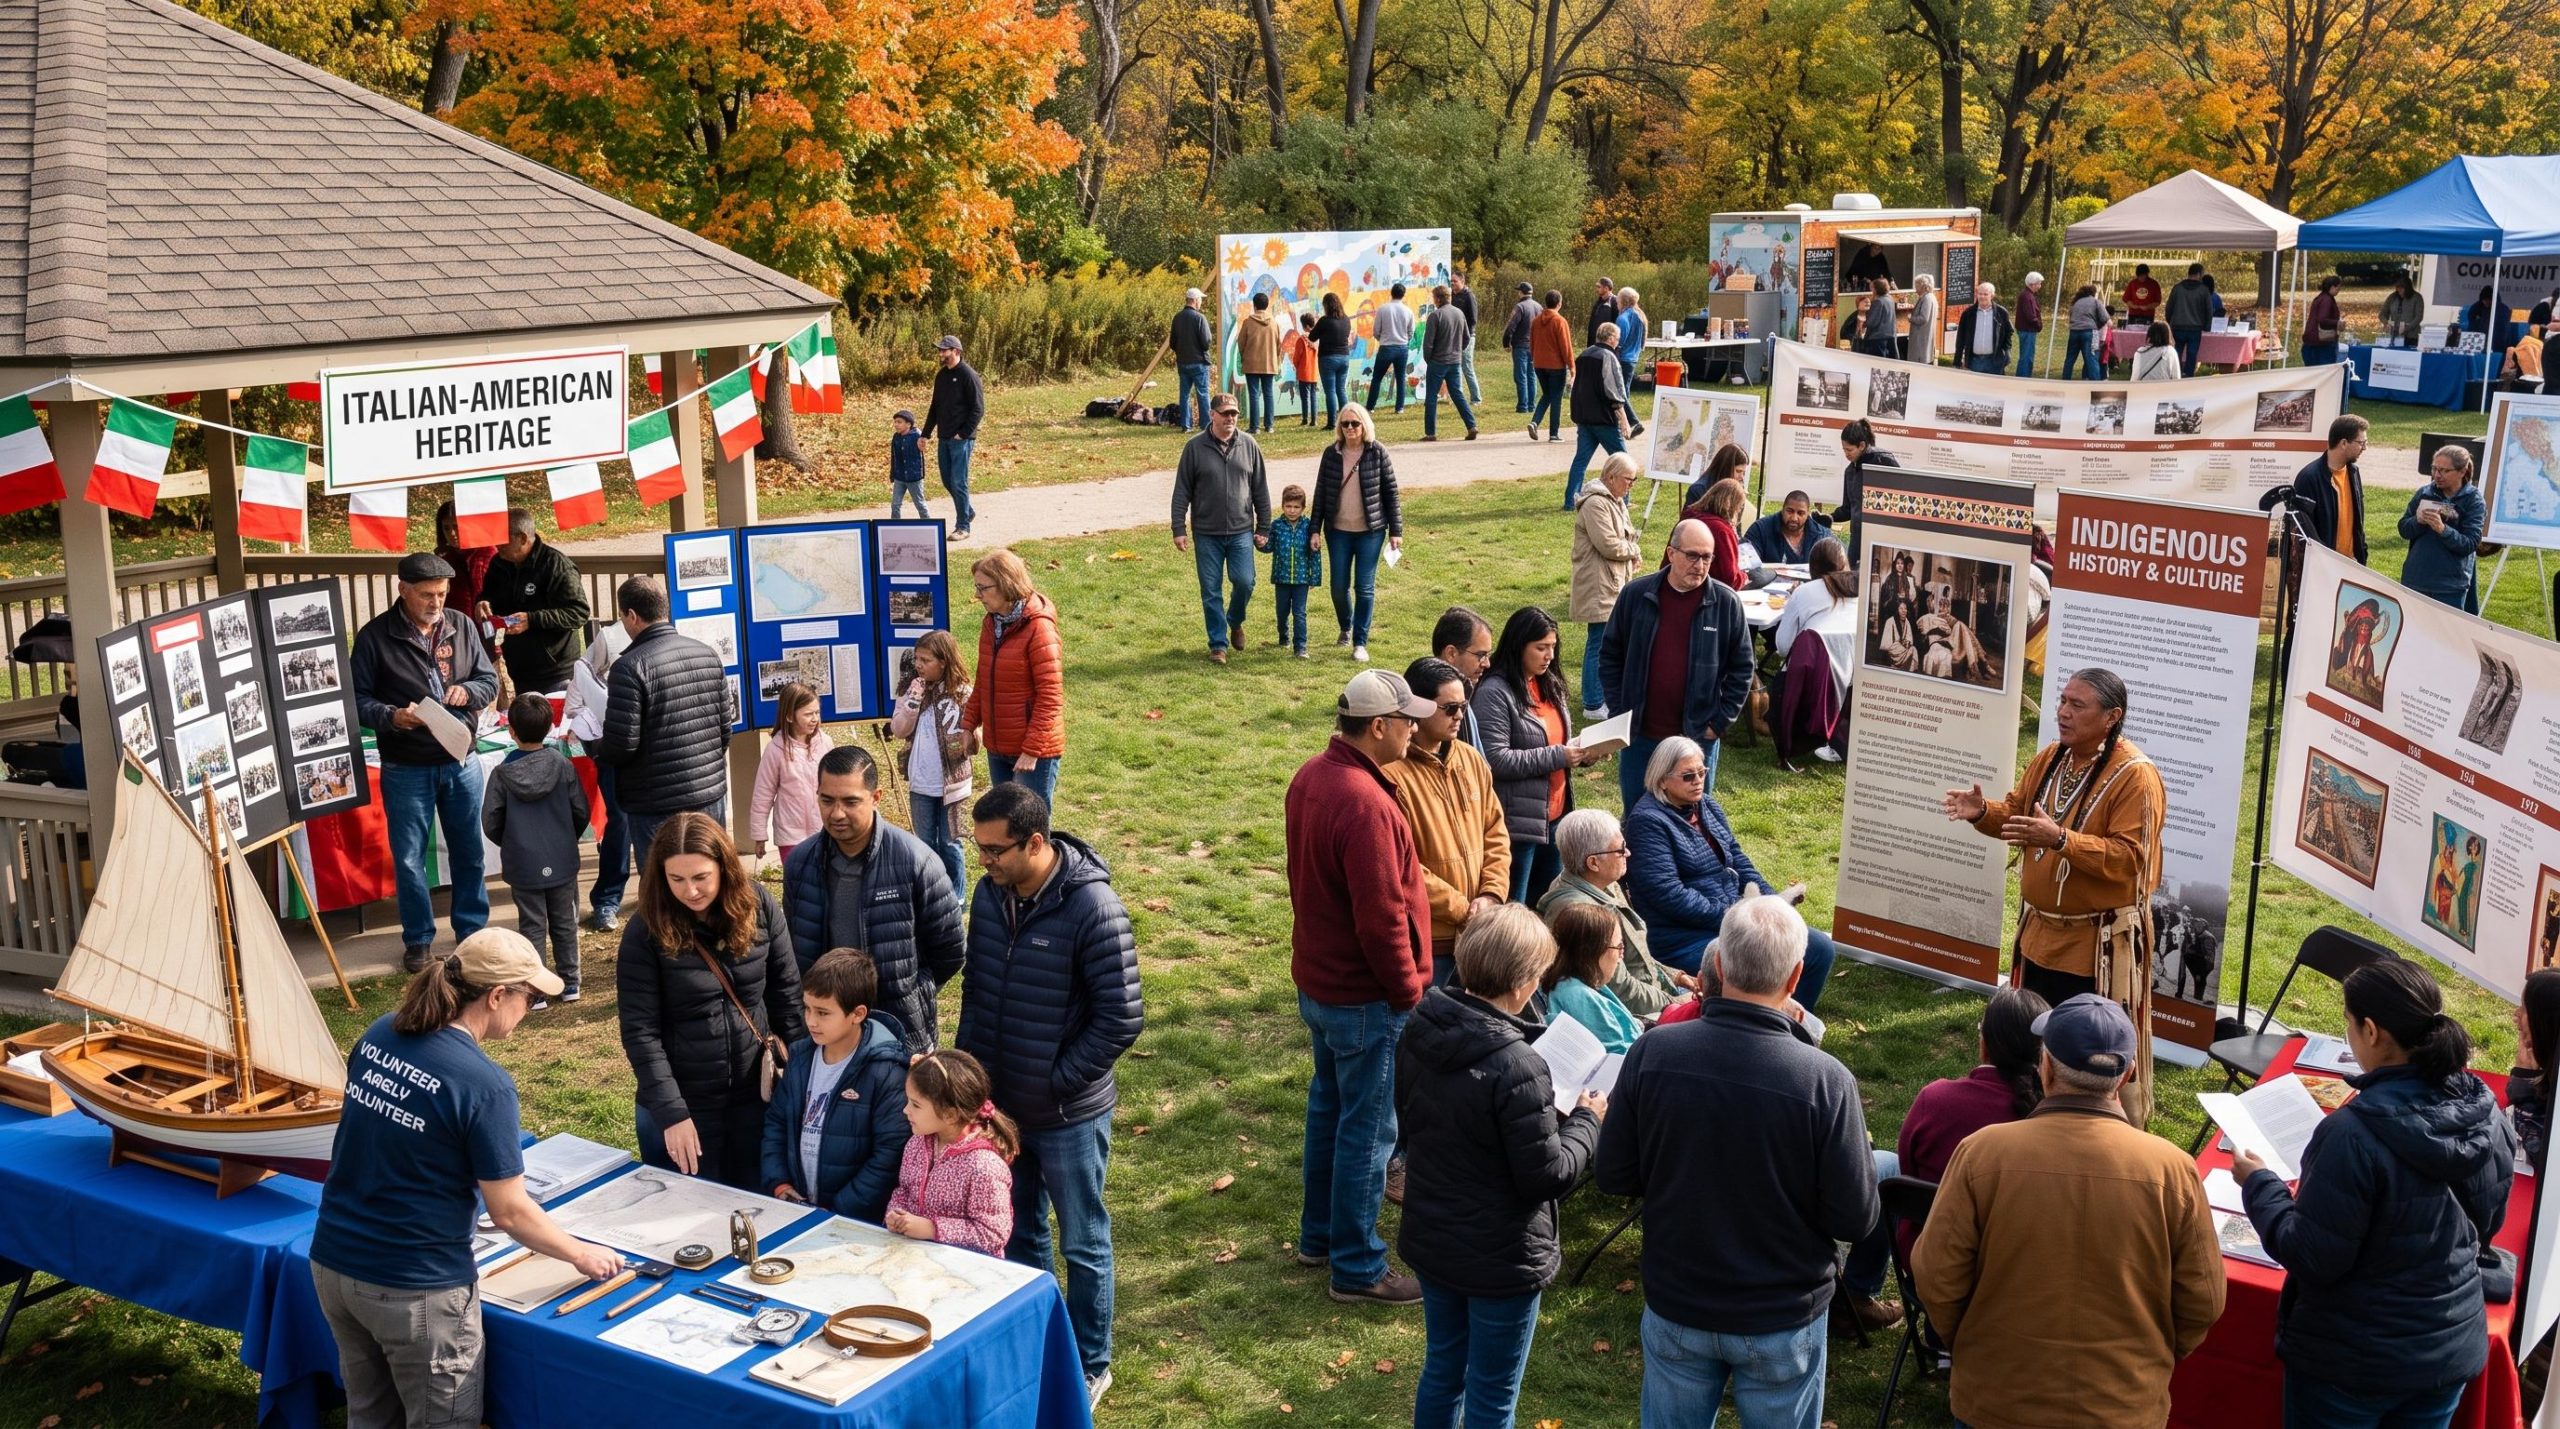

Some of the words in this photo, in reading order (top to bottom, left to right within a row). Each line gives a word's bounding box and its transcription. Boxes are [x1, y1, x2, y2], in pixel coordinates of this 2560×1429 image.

[342, 370, 613, 425] ITALIAN-AMERICAN
[416, 416, 552, 460] HERITAGE
[2071, 516, 2248, 567] INDIGENOUS
[2068, 551, 2143, 579] HISTORY
[2145, 562, 2159, 582] &
[2164, 564, 2245, 594] CULTURE
[360, 1041, 441, 1094] VOLUNTEER
